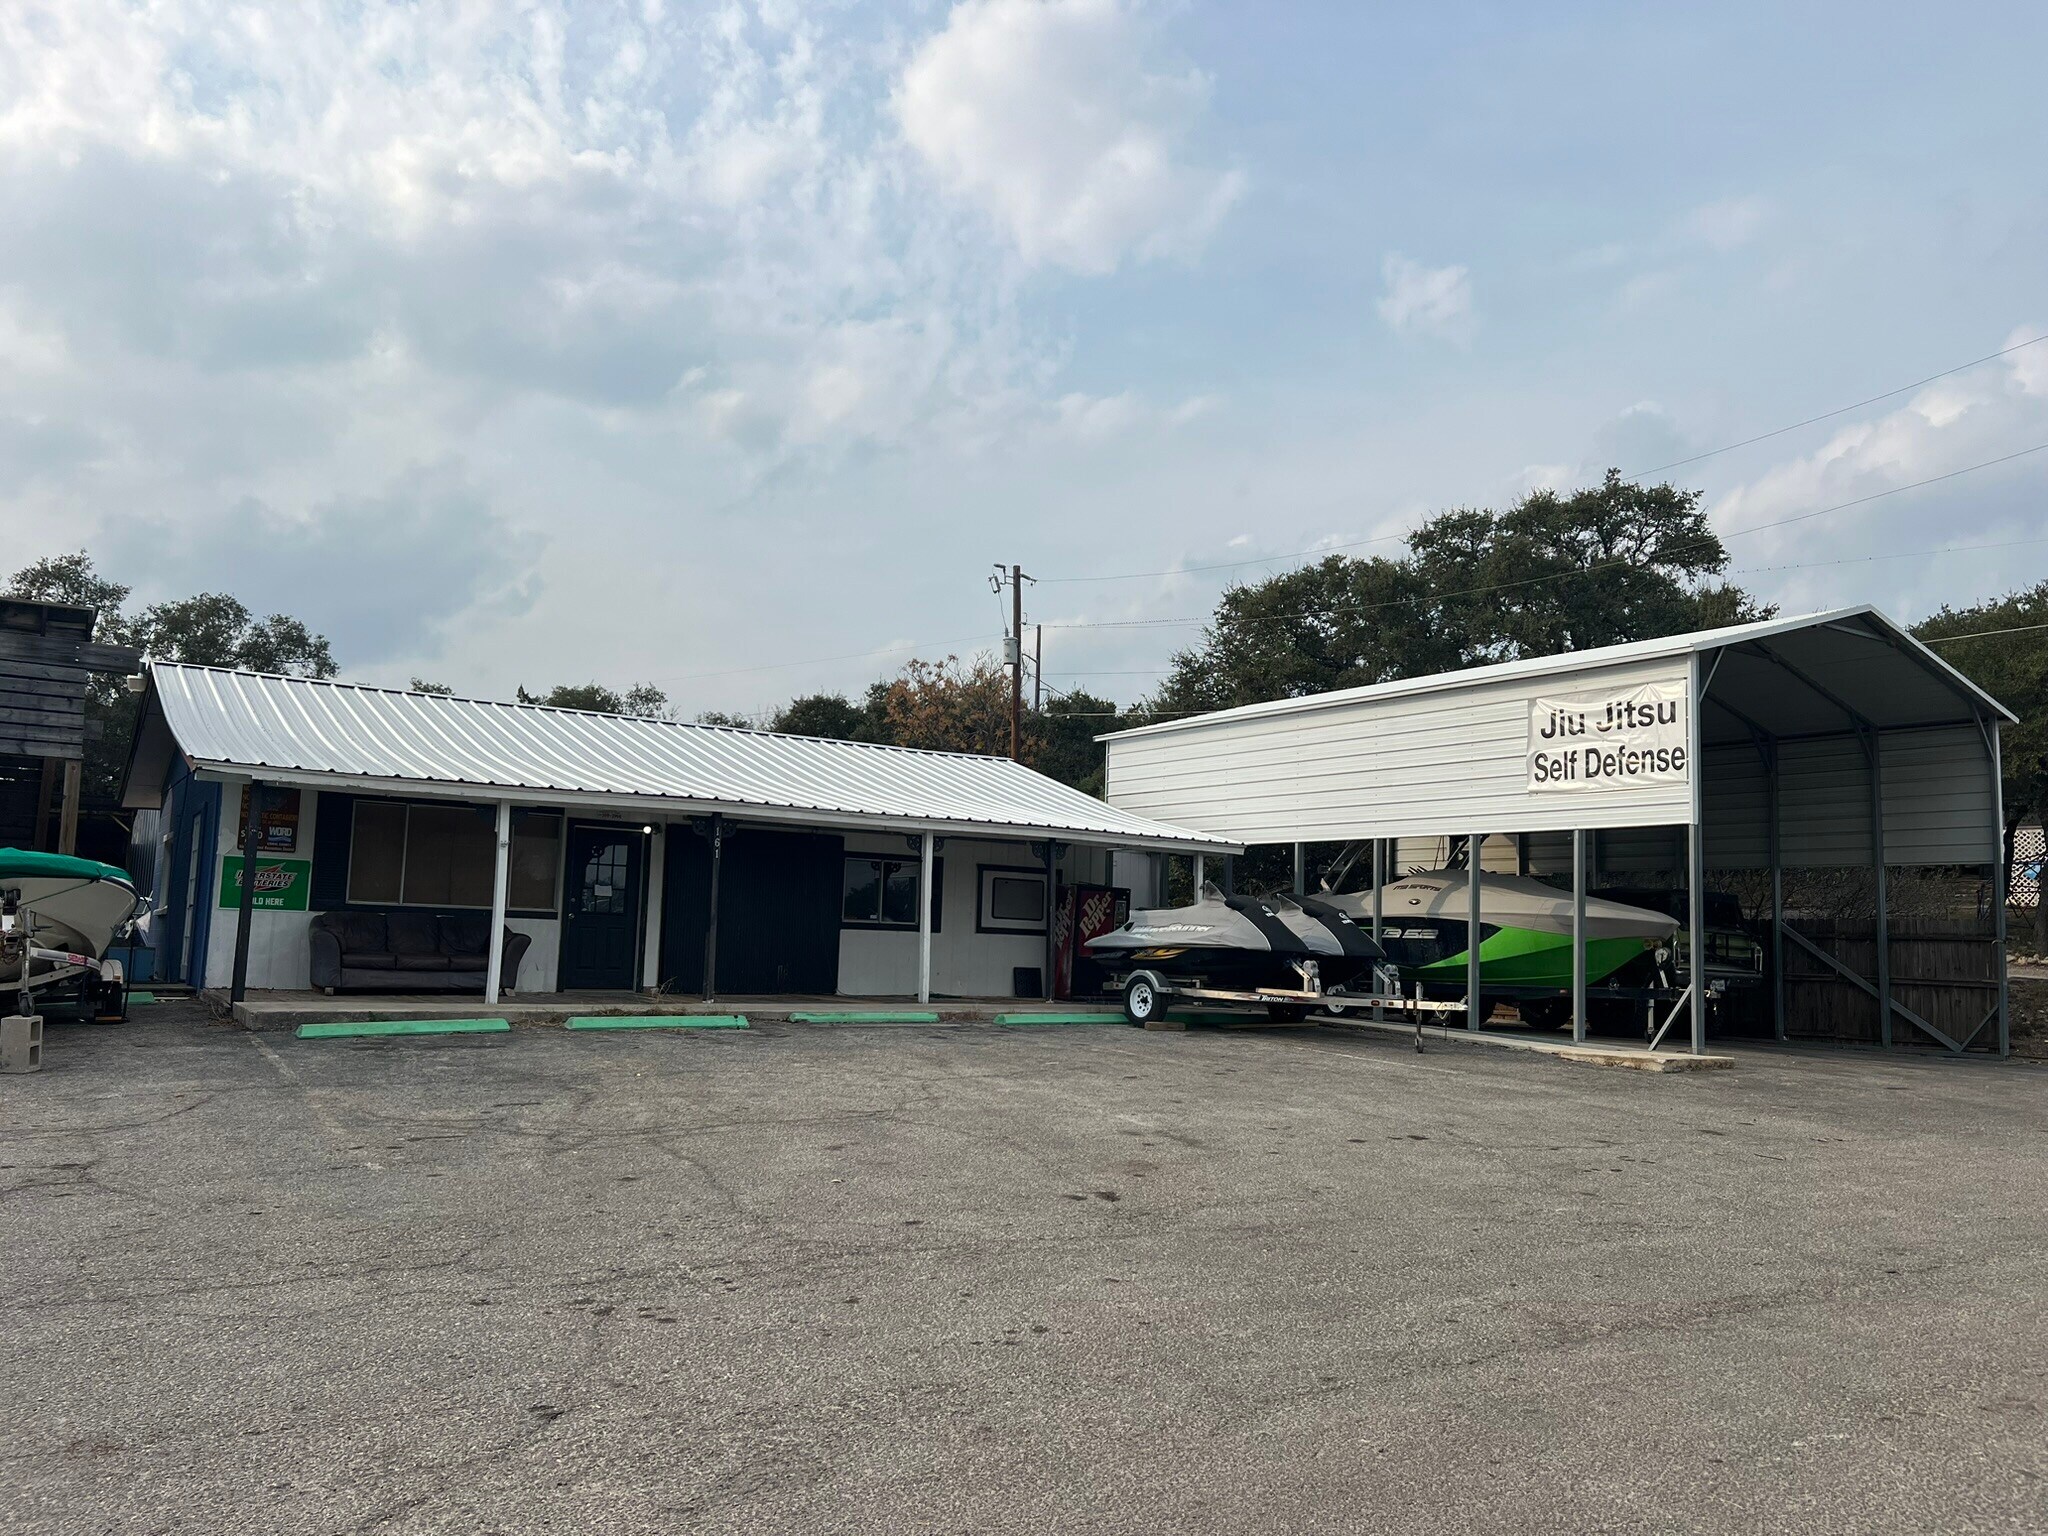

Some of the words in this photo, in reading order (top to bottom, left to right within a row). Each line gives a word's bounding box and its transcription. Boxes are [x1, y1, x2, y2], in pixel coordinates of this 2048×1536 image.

[1540, 708, 1586, 739] Jiu
[1596, 700, 1677, 732] Jitsu
[1534, 750, 1577, 783] Self
[1585, 745, 1685, 778] Defense
[269, 826, 292, 836] WORD
[265, 897, 285, 906] HERE
[1079, 891, 1112, 939] Pepper
[1082, 894, 1100, 918] Dr
